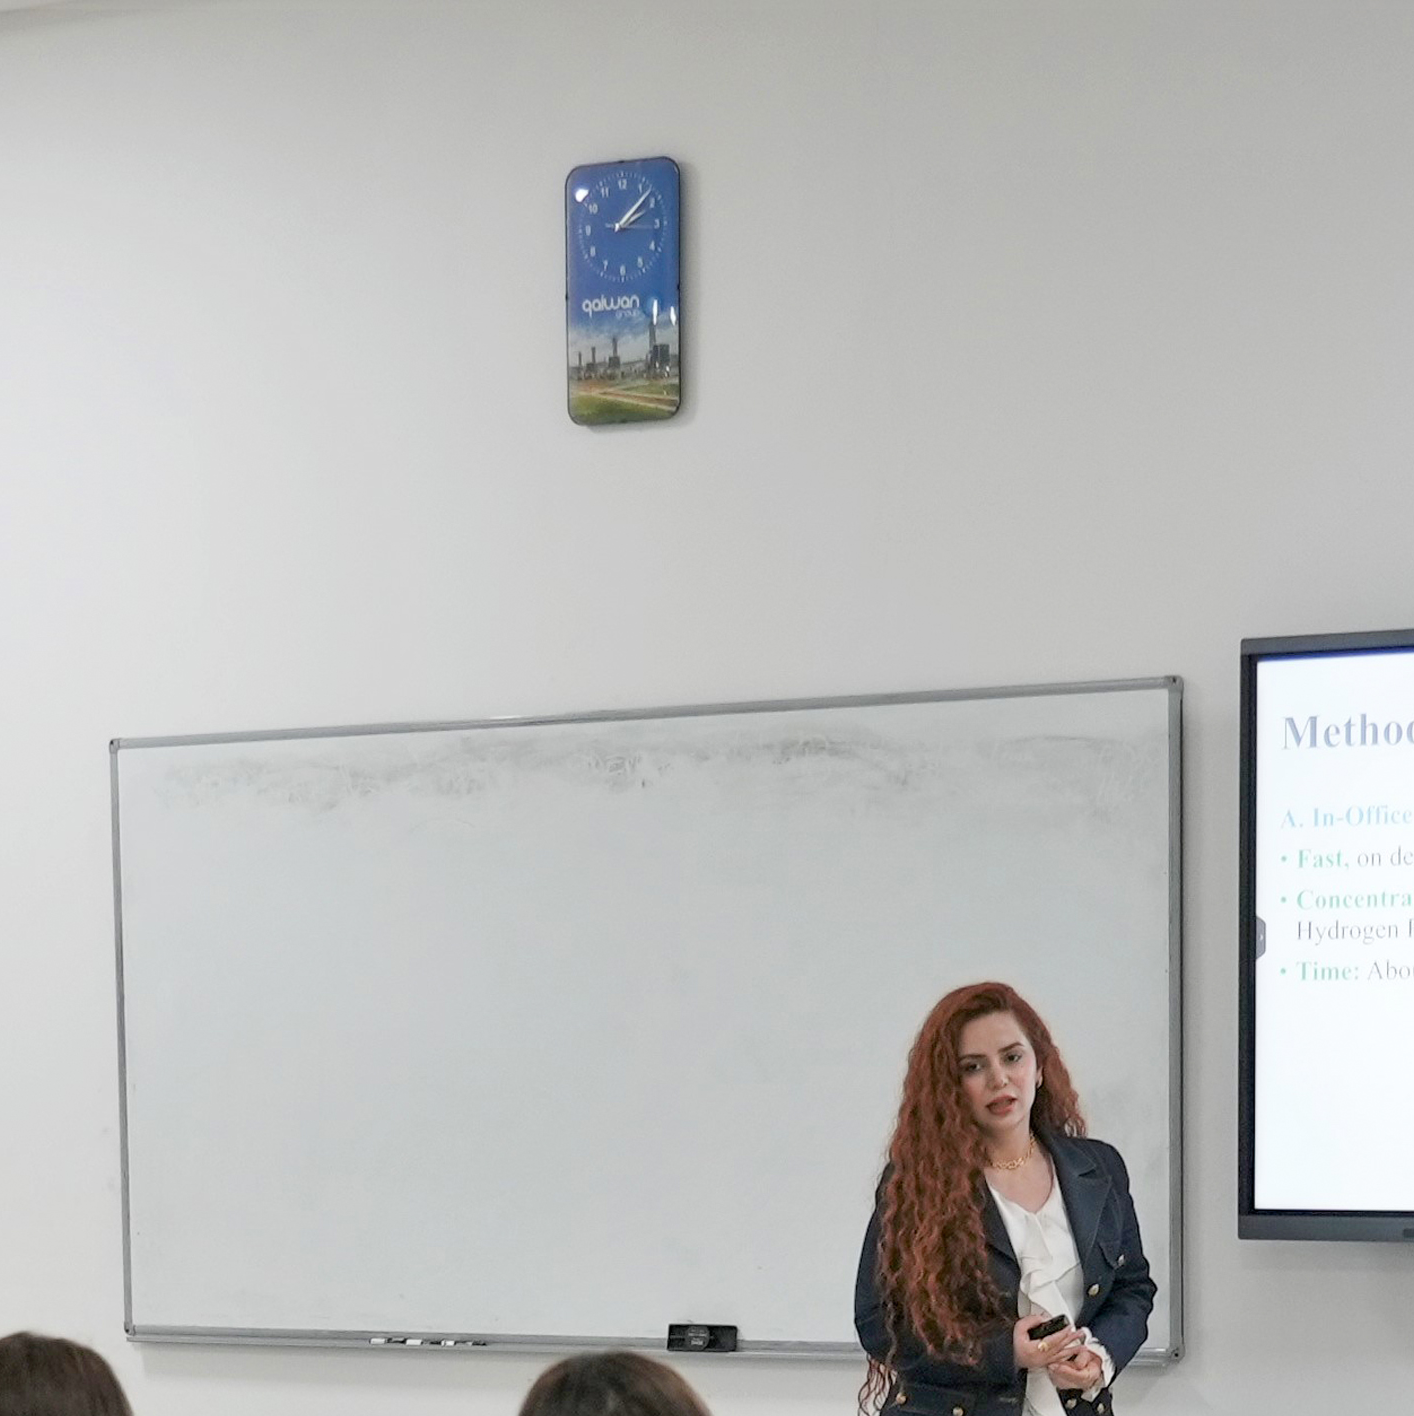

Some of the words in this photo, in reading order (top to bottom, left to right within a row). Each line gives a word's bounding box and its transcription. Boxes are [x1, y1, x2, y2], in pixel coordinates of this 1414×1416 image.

[617, 179, 627, 190] 12
[601, 187, 609, 198] 11
[588, 203, 598, 214] 10
[653, 218, 660, 229] 3
[649, 240, 656, 251] 4
[603, 260, 608, 271] 7
[582, 294, 640, 318] qaiwan
[1281, 808, 1304, 829] A.
[1313, 803, 1413, 828] In-Office
[1298, 849, 1350, 870] Fast,
[1357, 852, 1382, 867] on
[1297, 919, 1399, 945] Hydrogen
[1296, 961, 1360, 982] Time:
